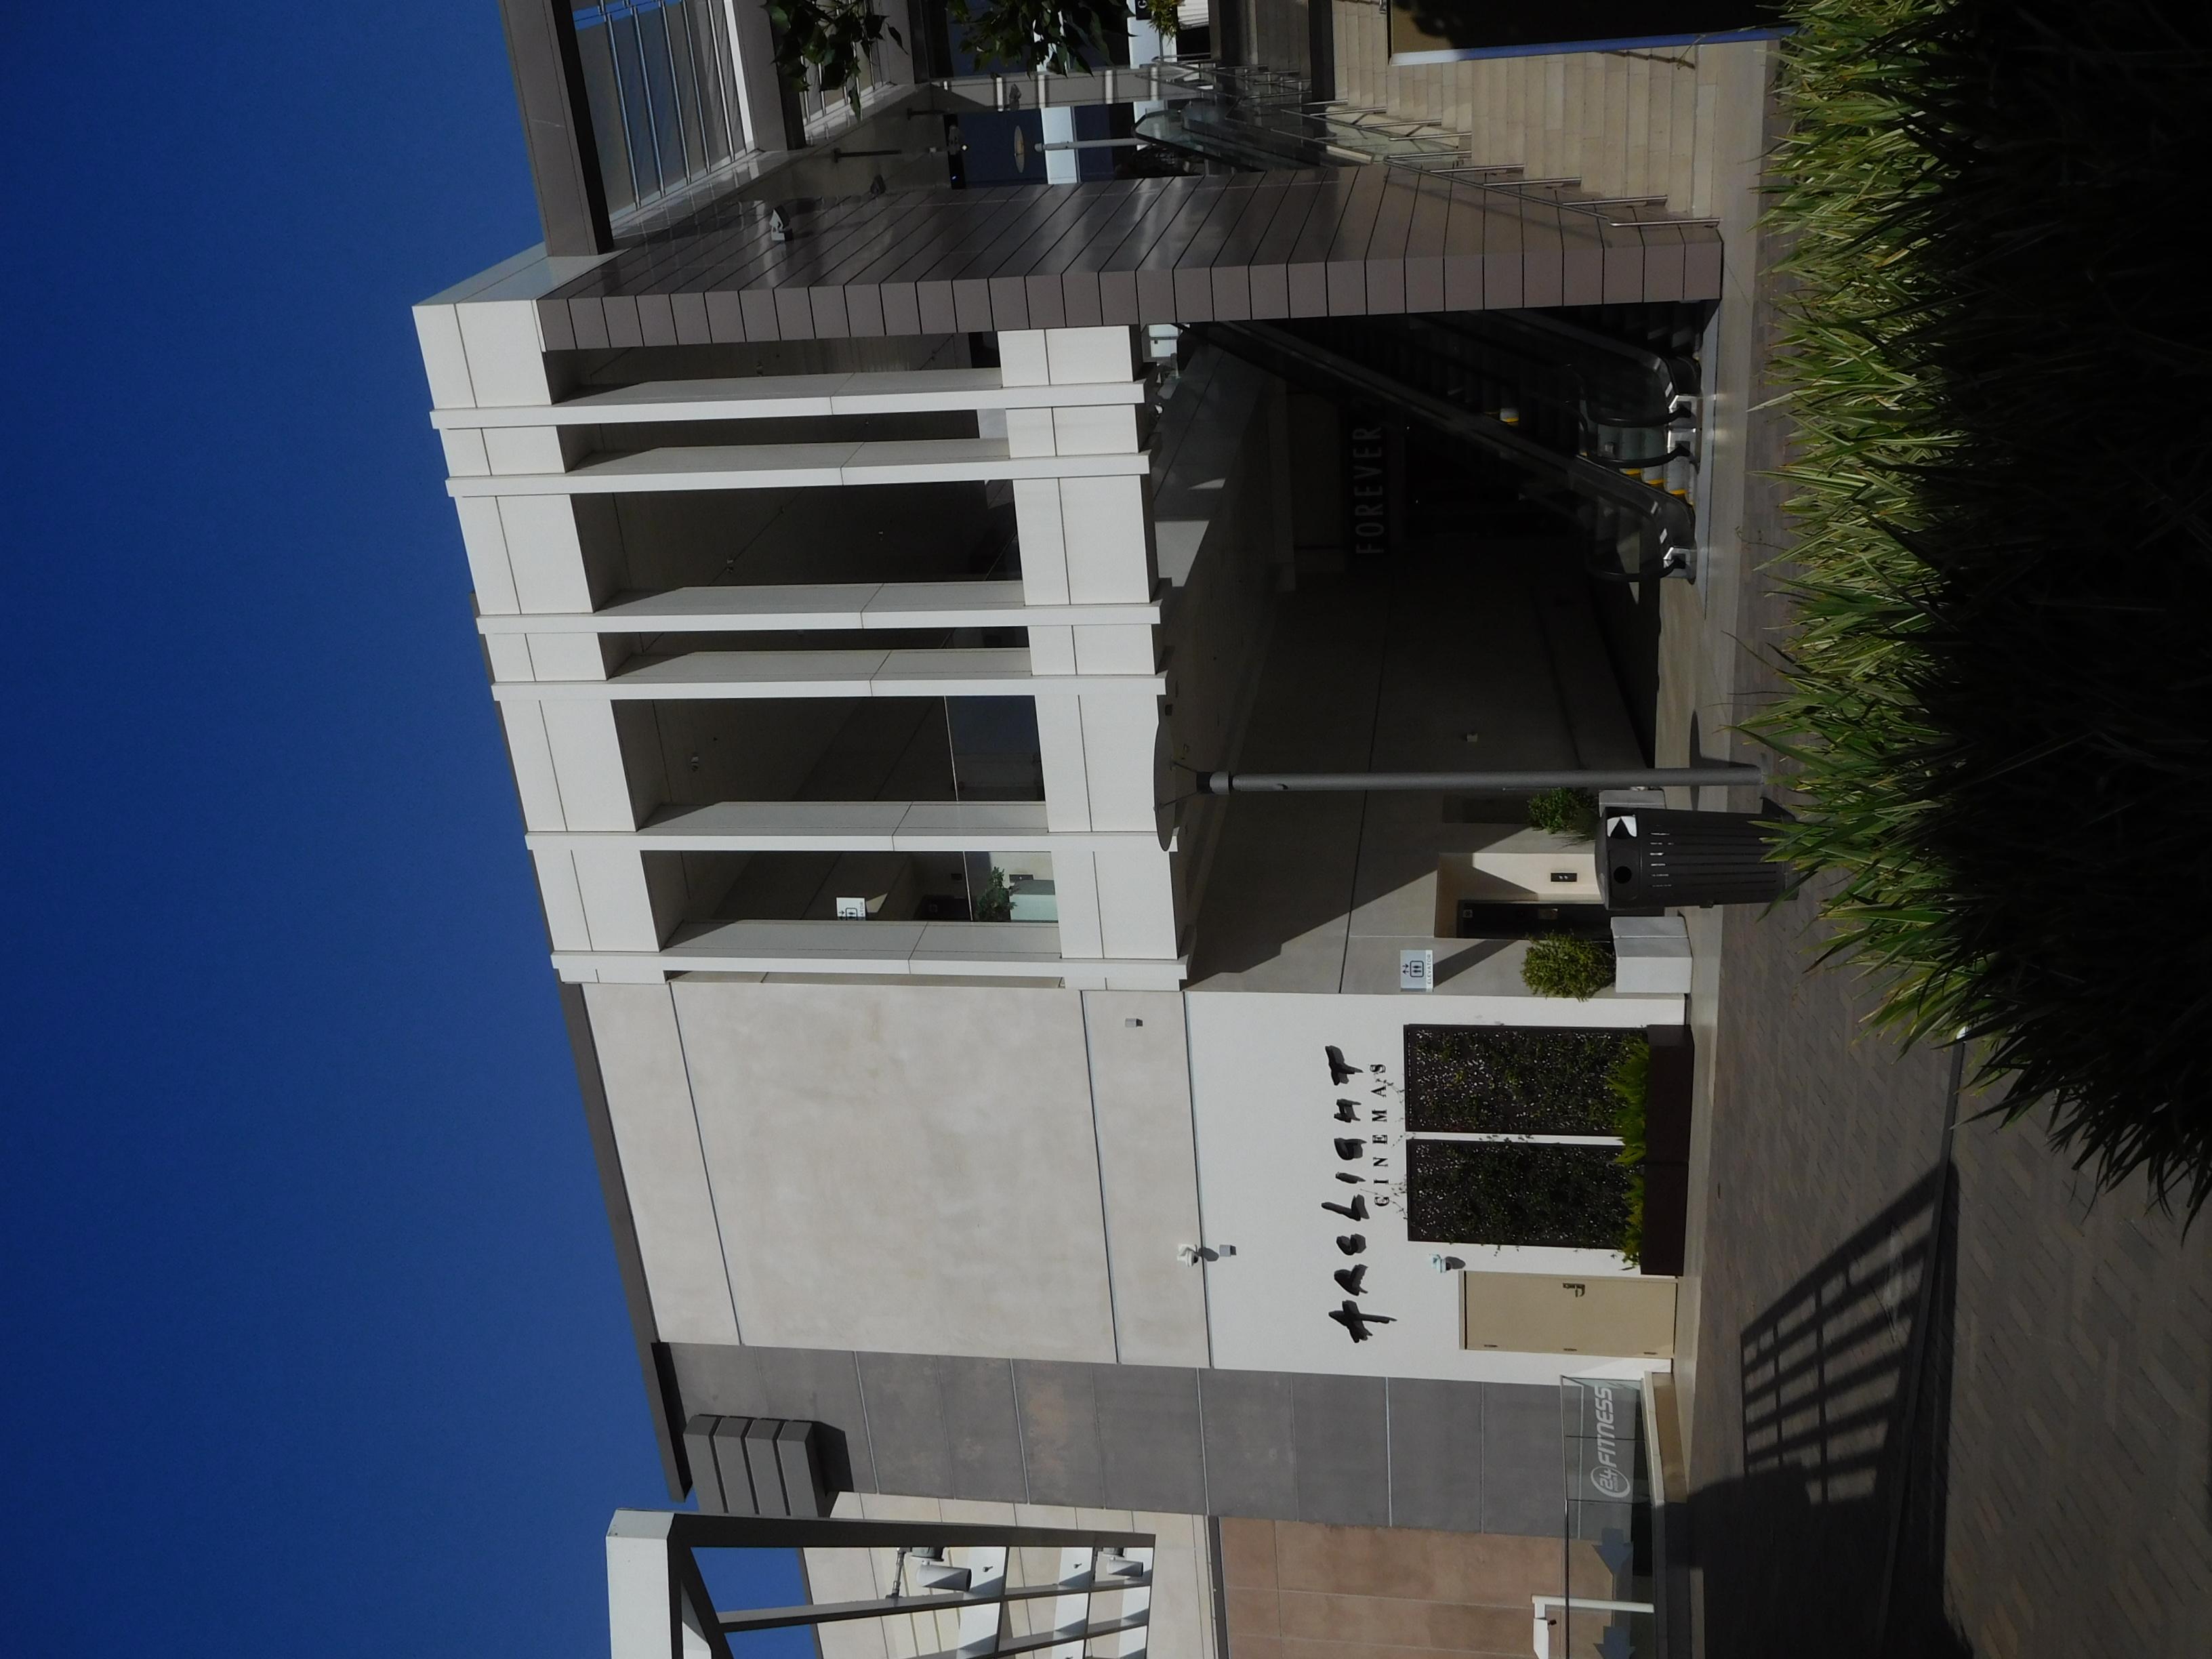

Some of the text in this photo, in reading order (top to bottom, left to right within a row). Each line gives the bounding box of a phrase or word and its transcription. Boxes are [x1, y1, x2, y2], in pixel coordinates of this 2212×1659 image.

[1351, 426, 1385, 554] FOREVER
[1369, 1064, 1389, 1206] CINEMAS
[1594, 1385, 1618, 1490] 24 FITNESS
